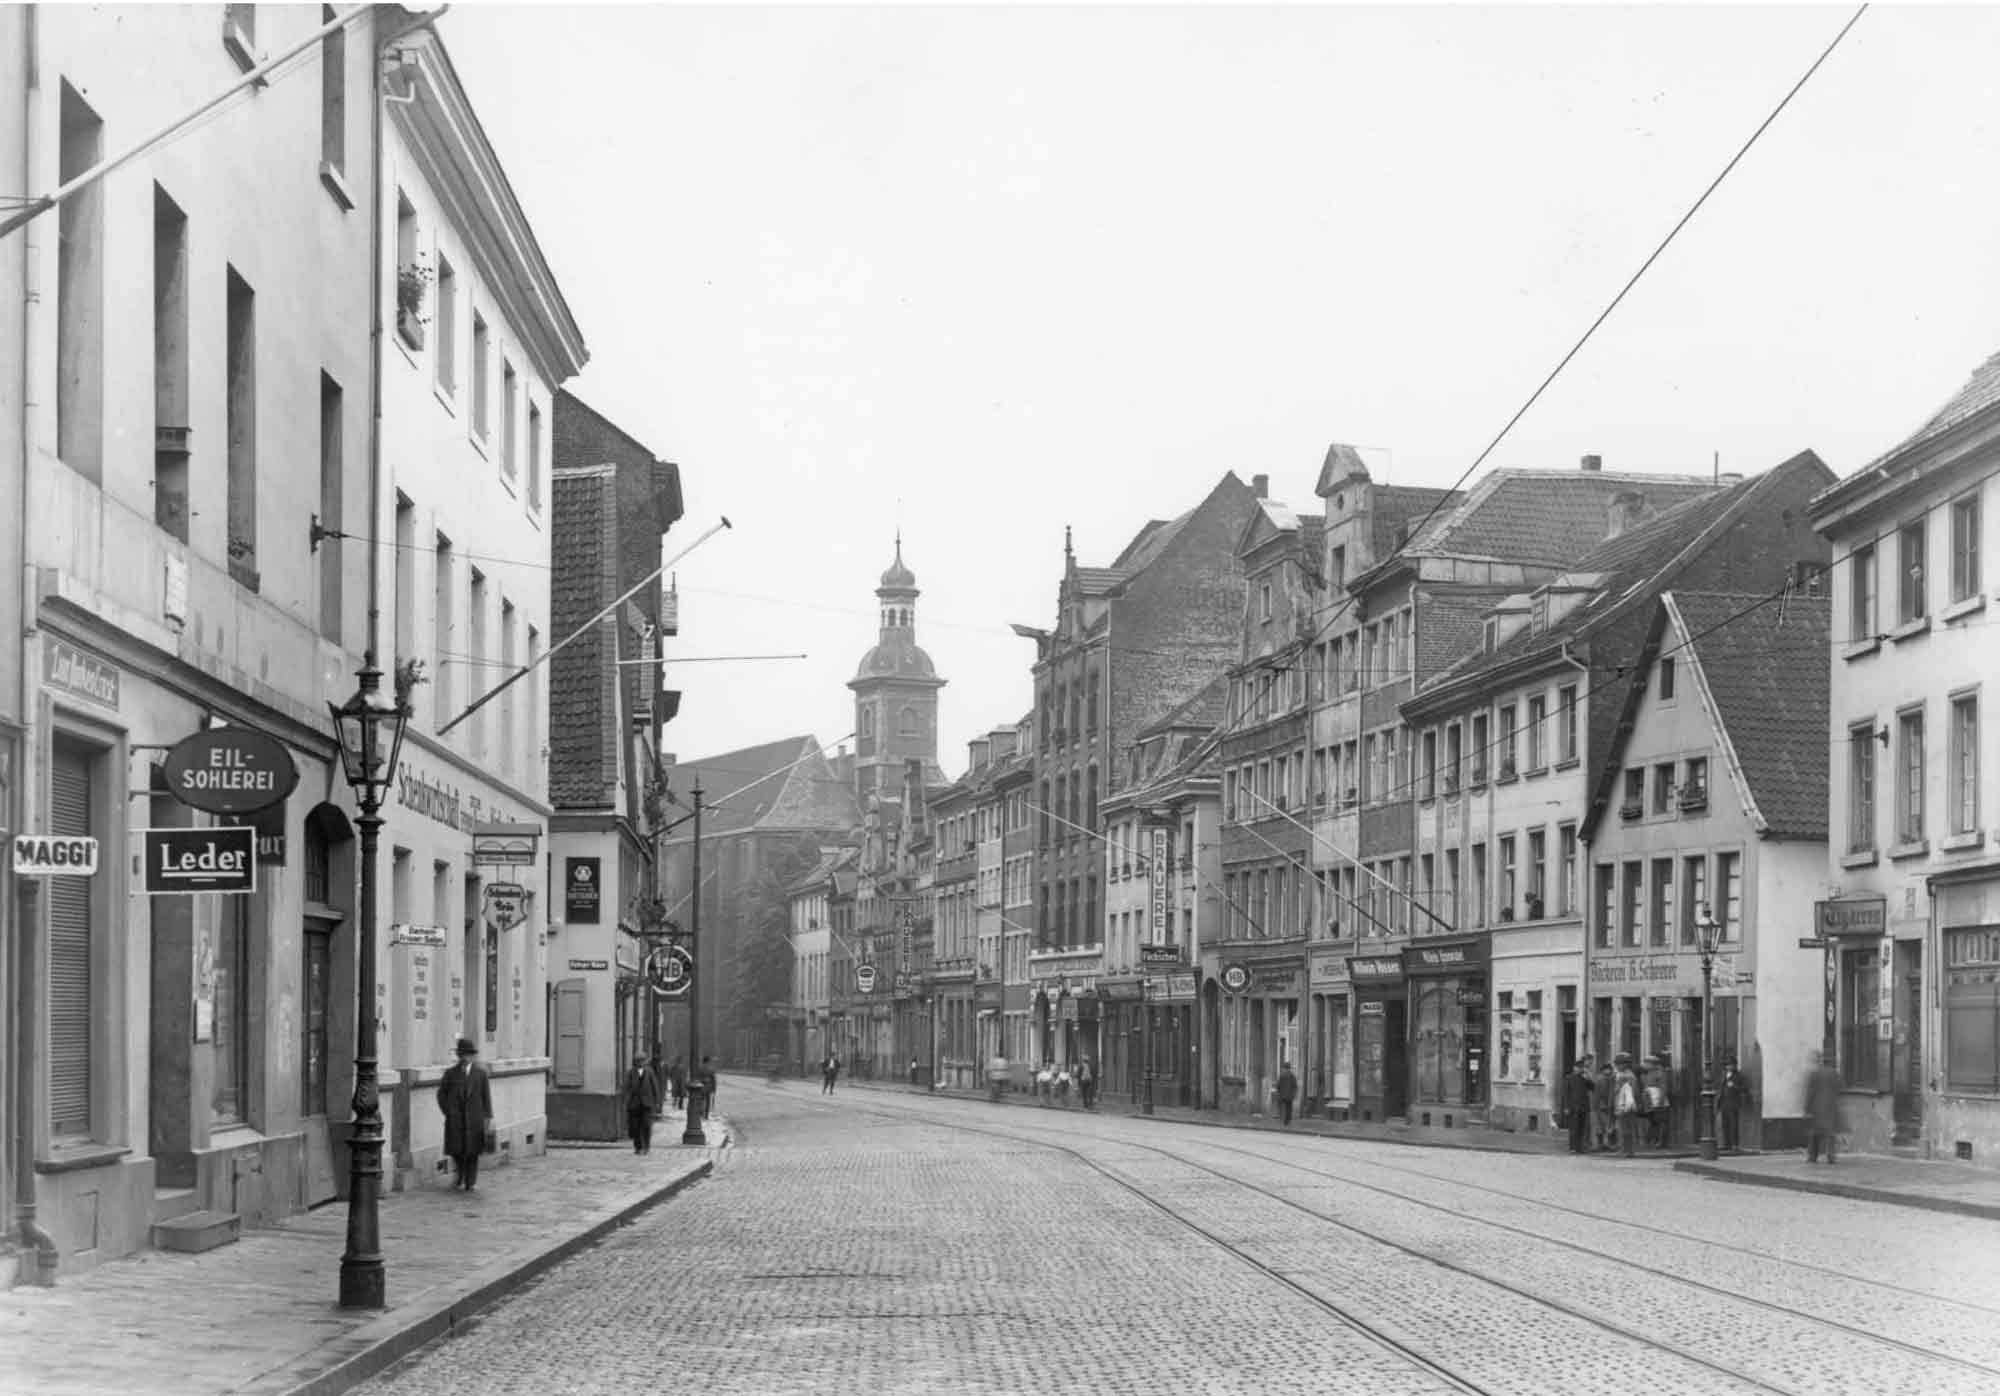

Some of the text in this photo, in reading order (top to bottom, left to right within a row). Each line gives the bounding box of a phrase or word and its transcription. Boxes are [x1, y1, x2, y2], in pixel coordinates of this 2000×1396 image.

[210, 748, 255, 767] EIL-
[182, 769, 274, 790] SOHLEREI
[16, 840, 91, 867] MAGGI
[161, 842, 246, 871] Leder
[1154, 831, 1166, 942] BRAUEREI
